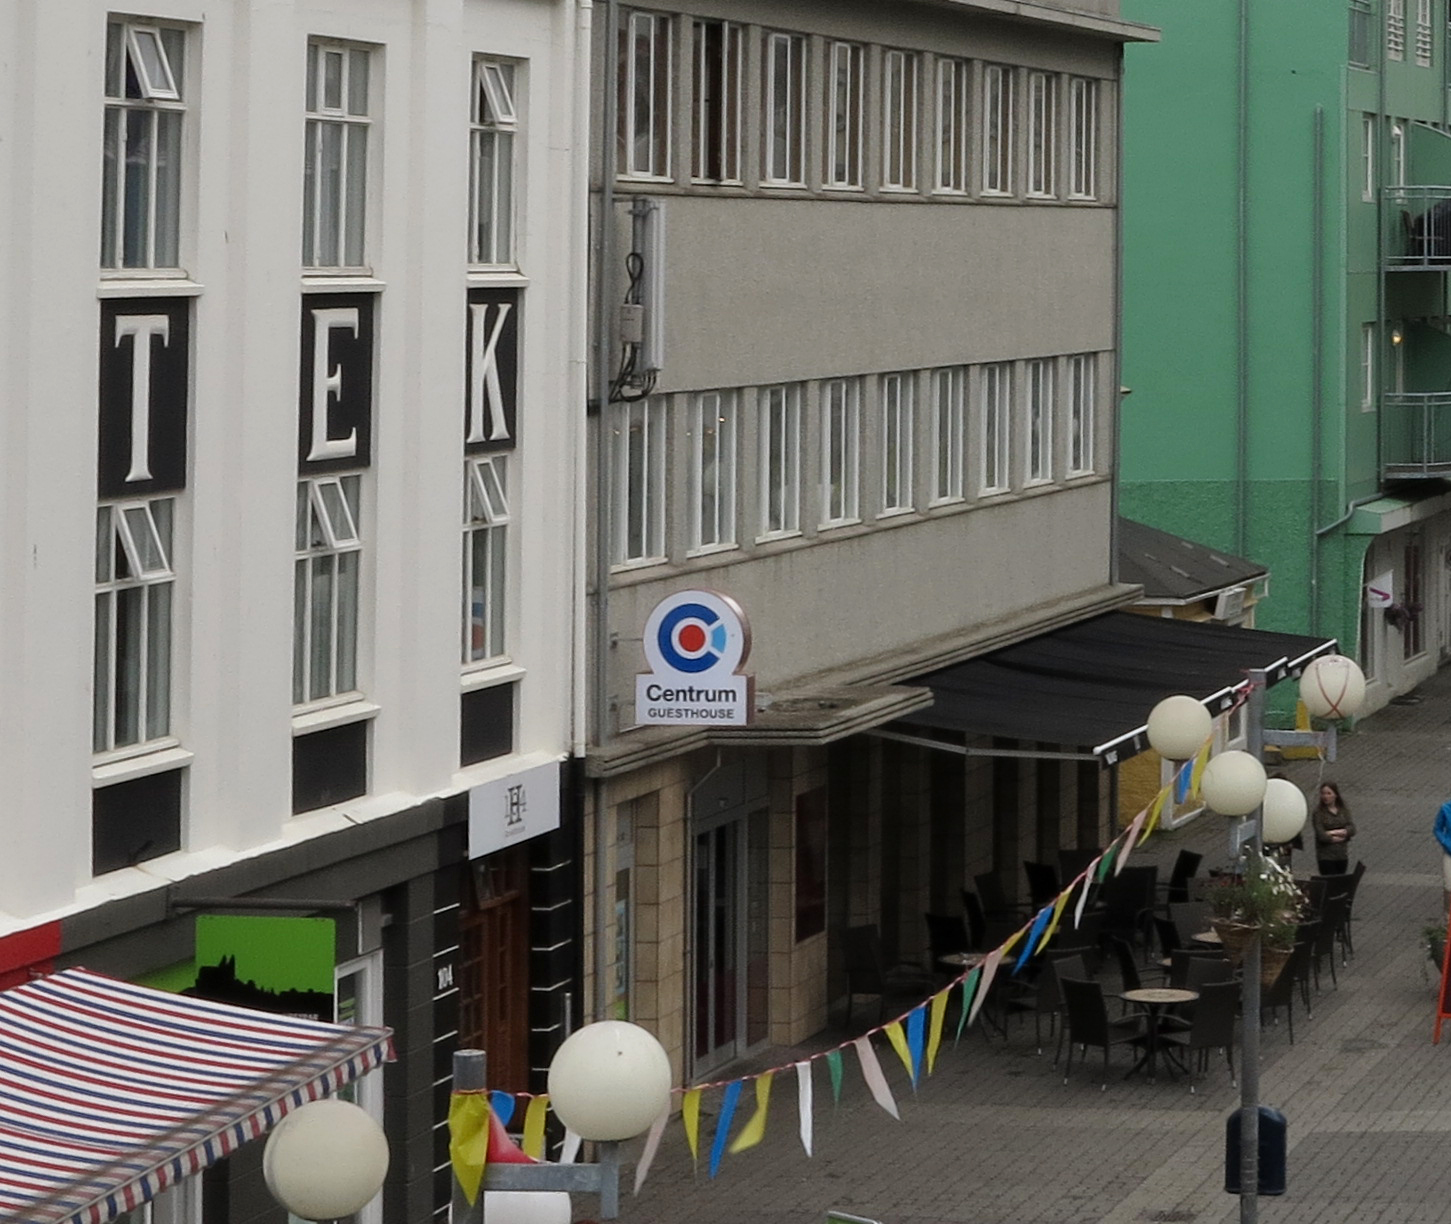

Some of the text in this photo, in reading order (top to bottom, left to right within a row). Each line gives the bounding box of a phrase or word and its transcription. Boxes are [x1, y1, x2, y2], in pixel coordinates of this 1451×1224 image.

[646, 684, 738, 703] Centrum
[647, 708, 735, 719] GUESTHOUSE
[438, 963, 454, 990] 104
